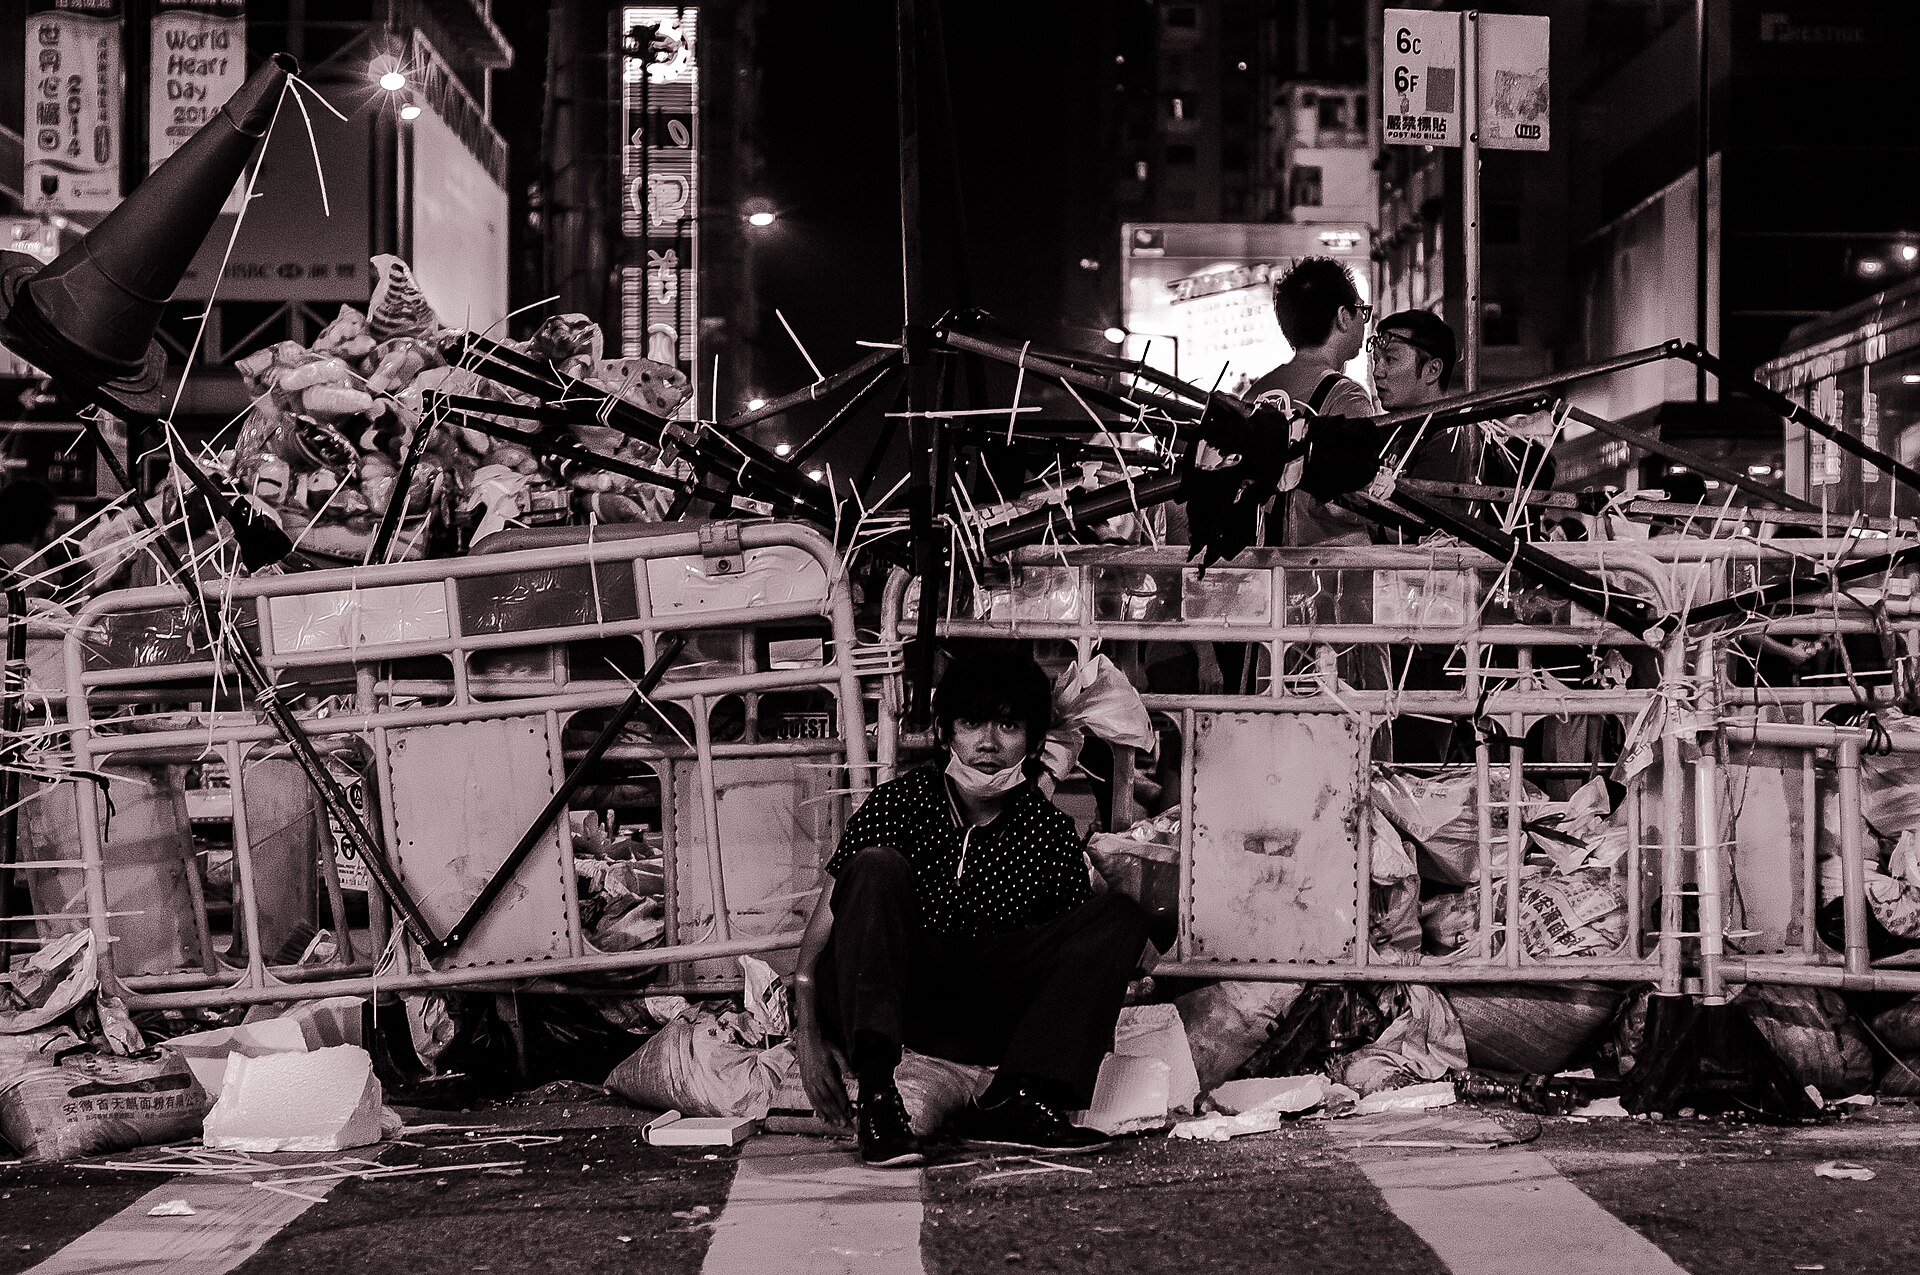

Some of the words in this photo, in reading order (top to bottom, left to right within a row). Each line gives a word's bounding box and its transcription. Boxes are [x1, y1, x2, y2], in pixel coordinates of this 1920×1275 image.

[165, 29, 229, 51] World
[1396, 27, 1422, 55] 6C
[167, 54, 228, 76] Heart
[166, 79, 206, 101] Day
[1394, 65, 1420, 93] 6F
[1387, 115, 1447, 132] 嚴禁標貼
[1388, 131, 1408, 139] POST
[1424, 132, 1446, 140] BILLS
